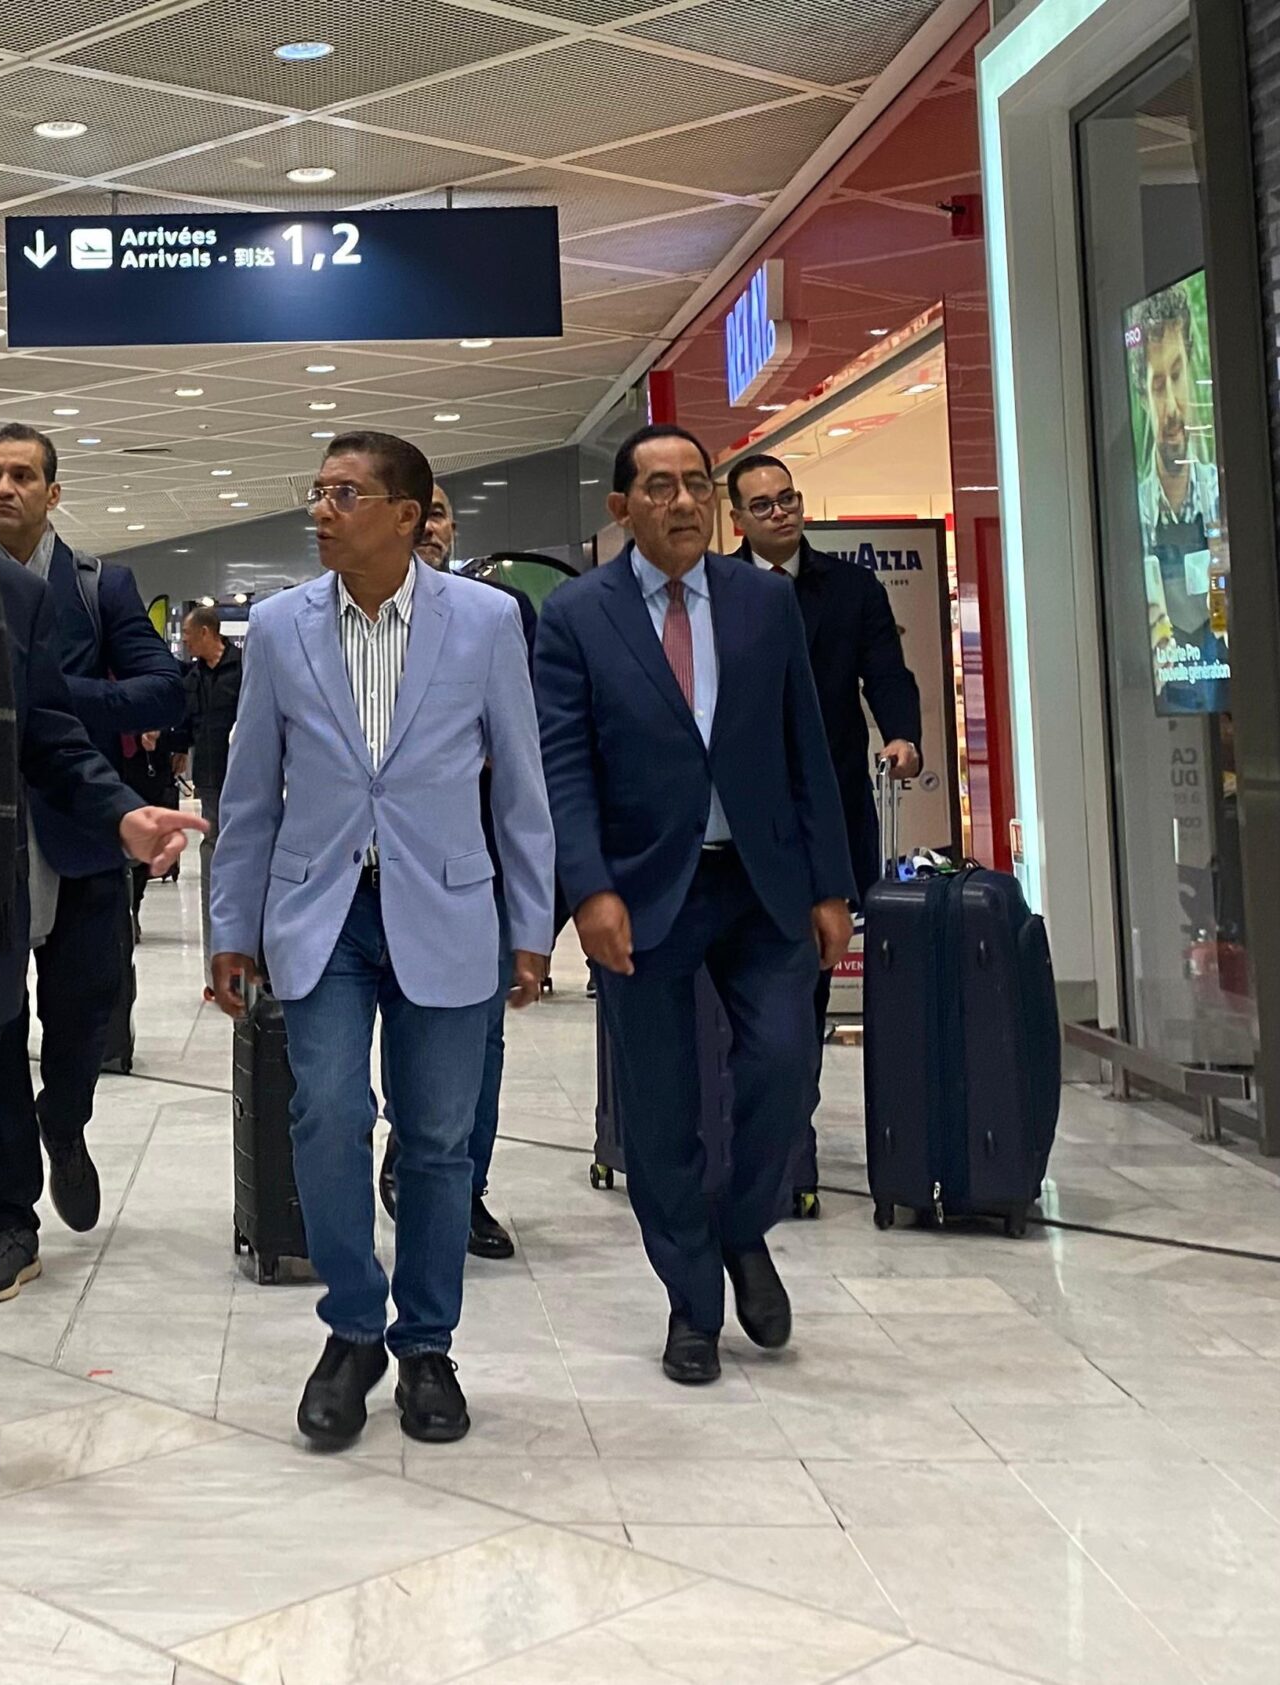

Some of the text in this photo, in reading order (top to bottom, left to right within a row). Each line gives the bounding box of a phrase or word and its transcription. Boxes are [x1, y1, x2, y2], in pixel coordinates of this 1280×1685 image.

[120, 226, 217, 246] Arrivées
[282, 222, 362, 272] 1,2
[120, 248, 211, 268] Arrivals
[233, 247, 275, 267] 到达
[1125, 327, 1141, 347] PRO
[1186, 643, 1201, 661] Pro
